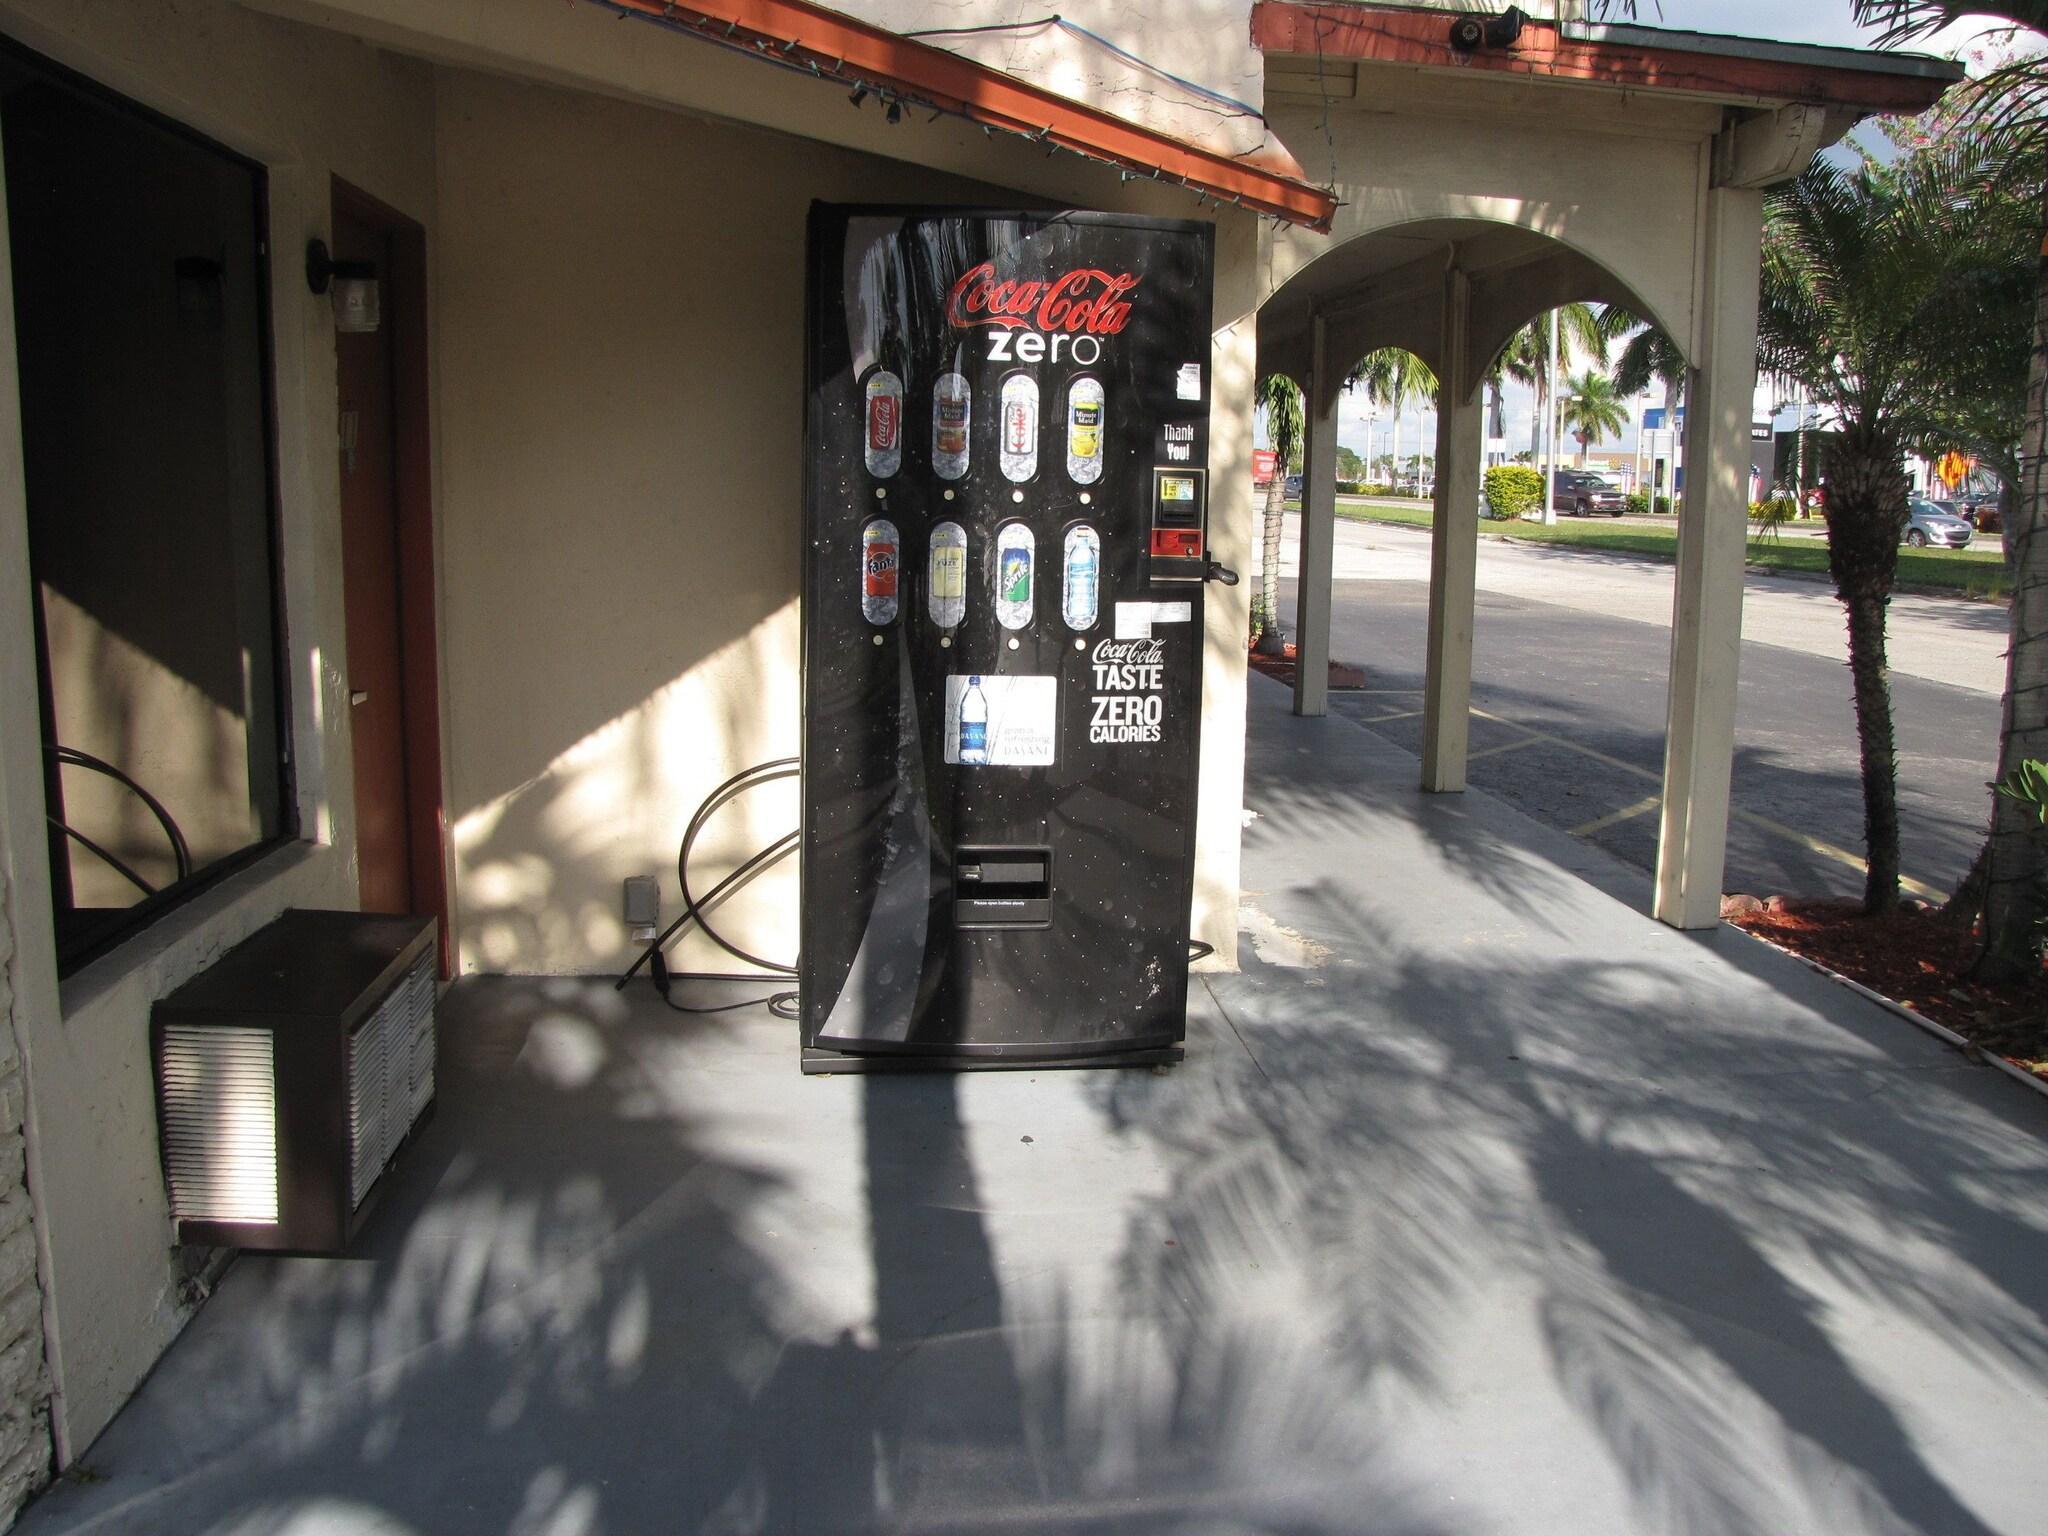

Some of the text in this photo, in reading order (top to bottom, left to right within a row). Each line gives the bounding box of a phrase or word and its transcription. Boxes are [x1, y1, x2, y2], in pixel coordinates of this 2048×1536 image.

[946, 263, 1142, 335] Coca-Cola
[986, 331, 1101, 366] zero
[1076, 410, 1096, 418] Minute
[1163, 424, 1194, 441] Thank
[1167, 443, 1190, 460] You!
[1004, 562, 1029, 593] Sprite
[1092, 638, 1166, 664] Coca-Cola
[1092, 664, 1164, 691] TASTE
[1090, 695, 1163, 726] ZERO
[1089, 725, 1161, 743] CALORIES
